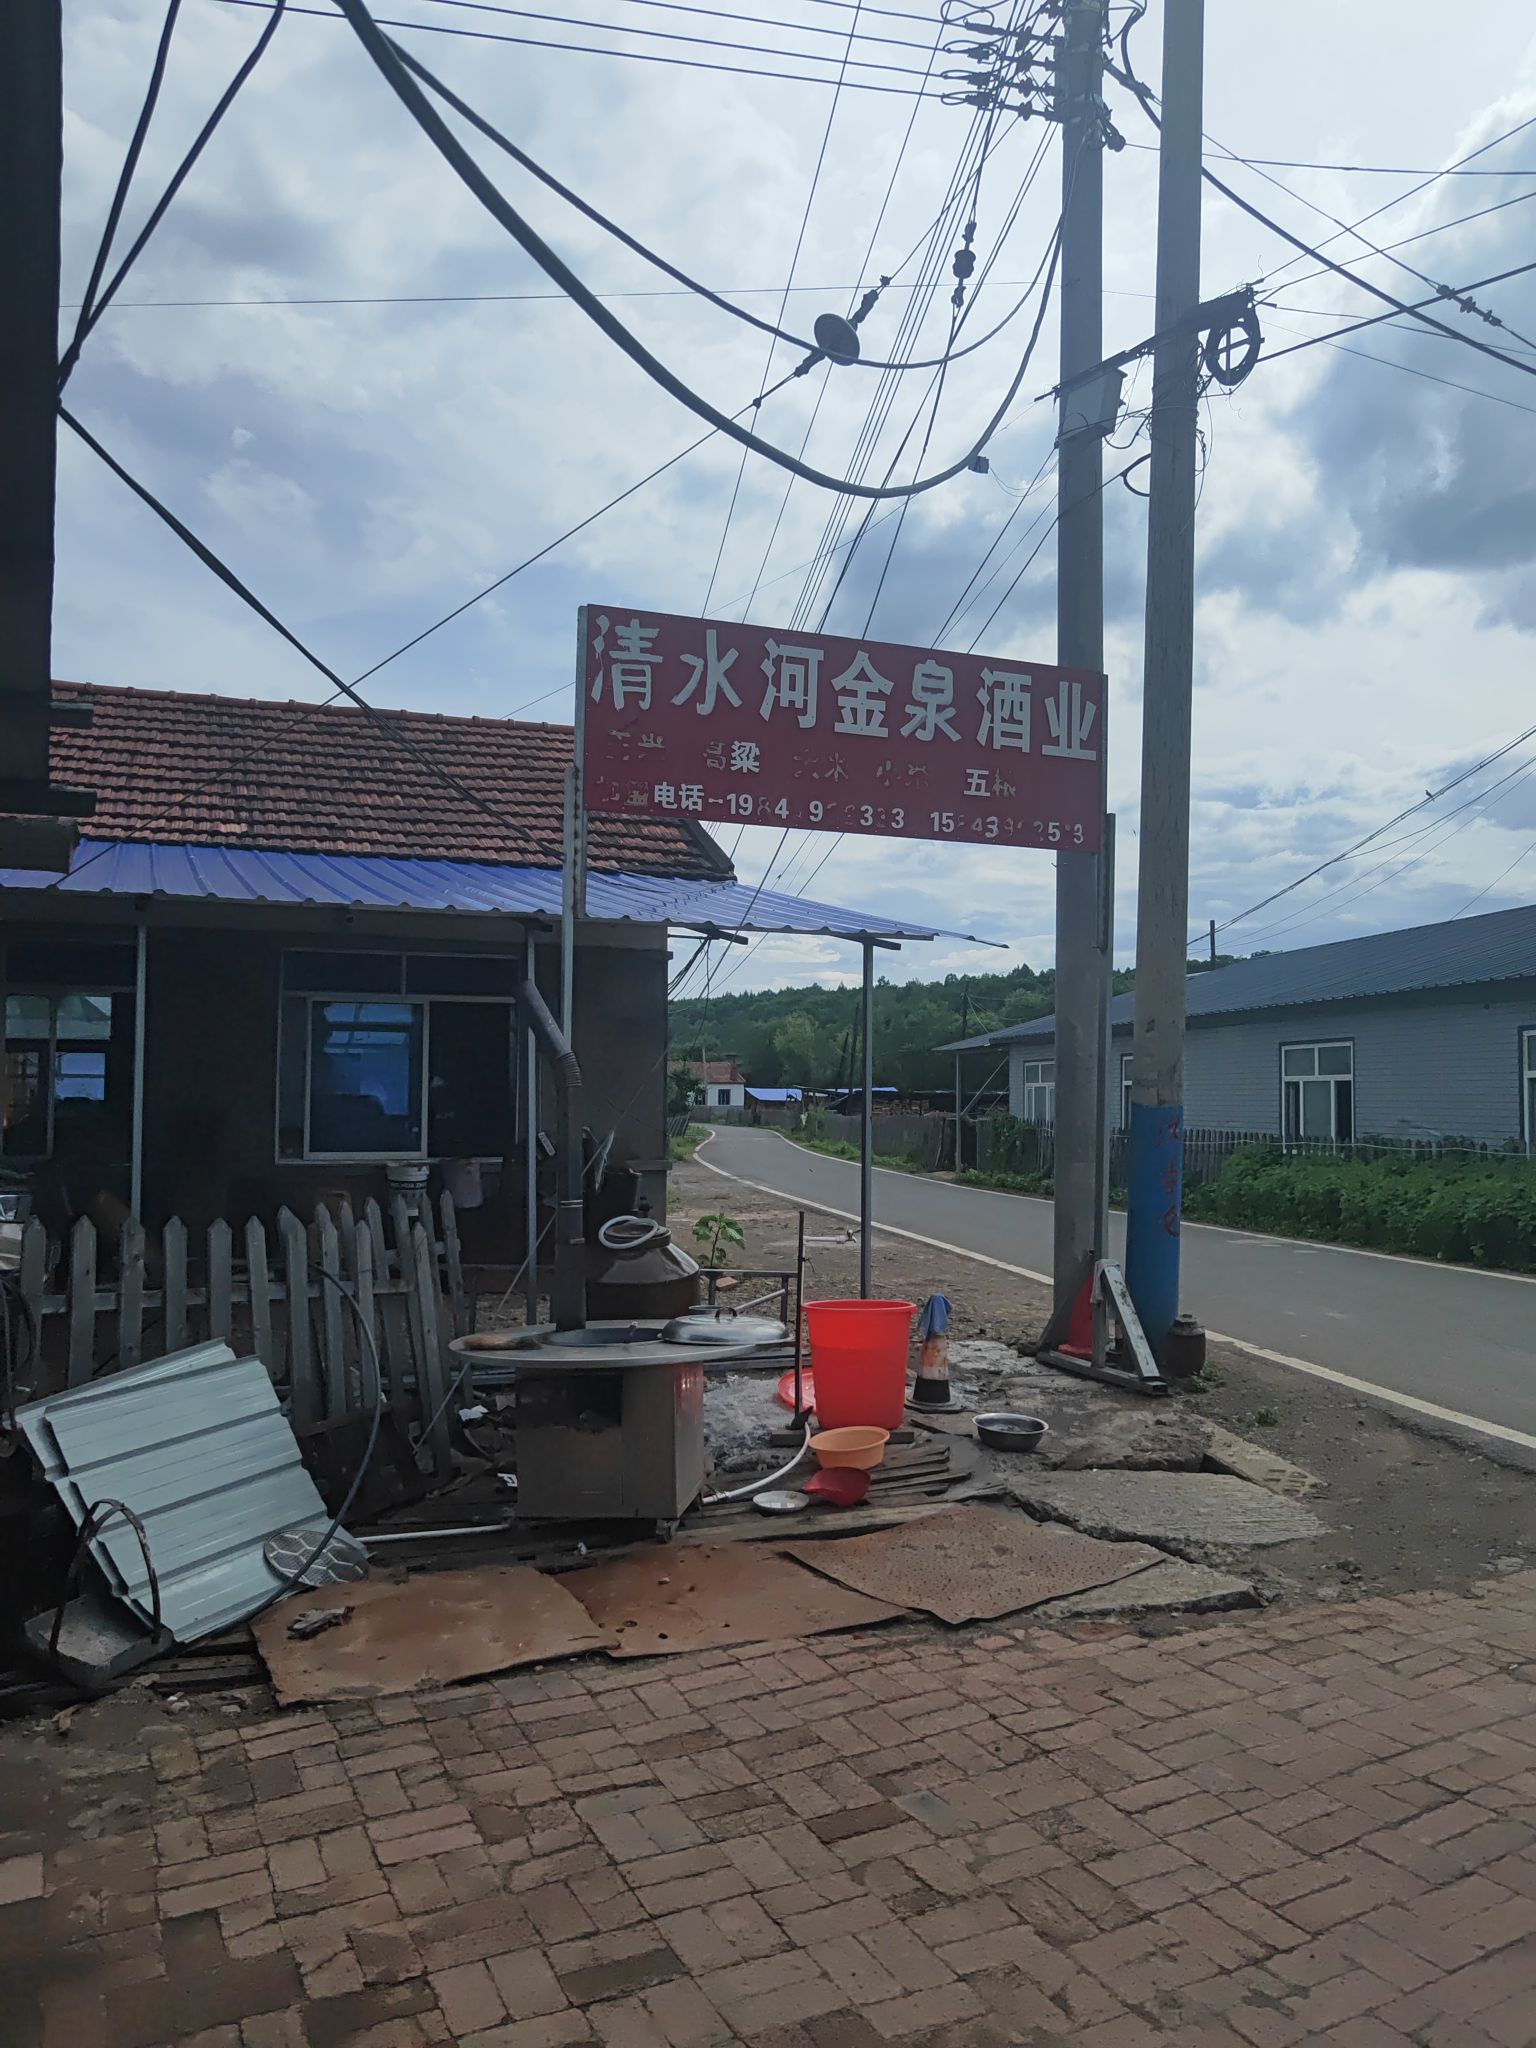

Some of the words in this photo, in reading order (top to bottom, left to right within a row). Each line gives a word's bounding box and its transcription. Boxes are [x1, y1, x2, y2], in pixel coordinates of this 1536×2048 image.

[591, 615, 1097, 762] 清水河金泉酒业
